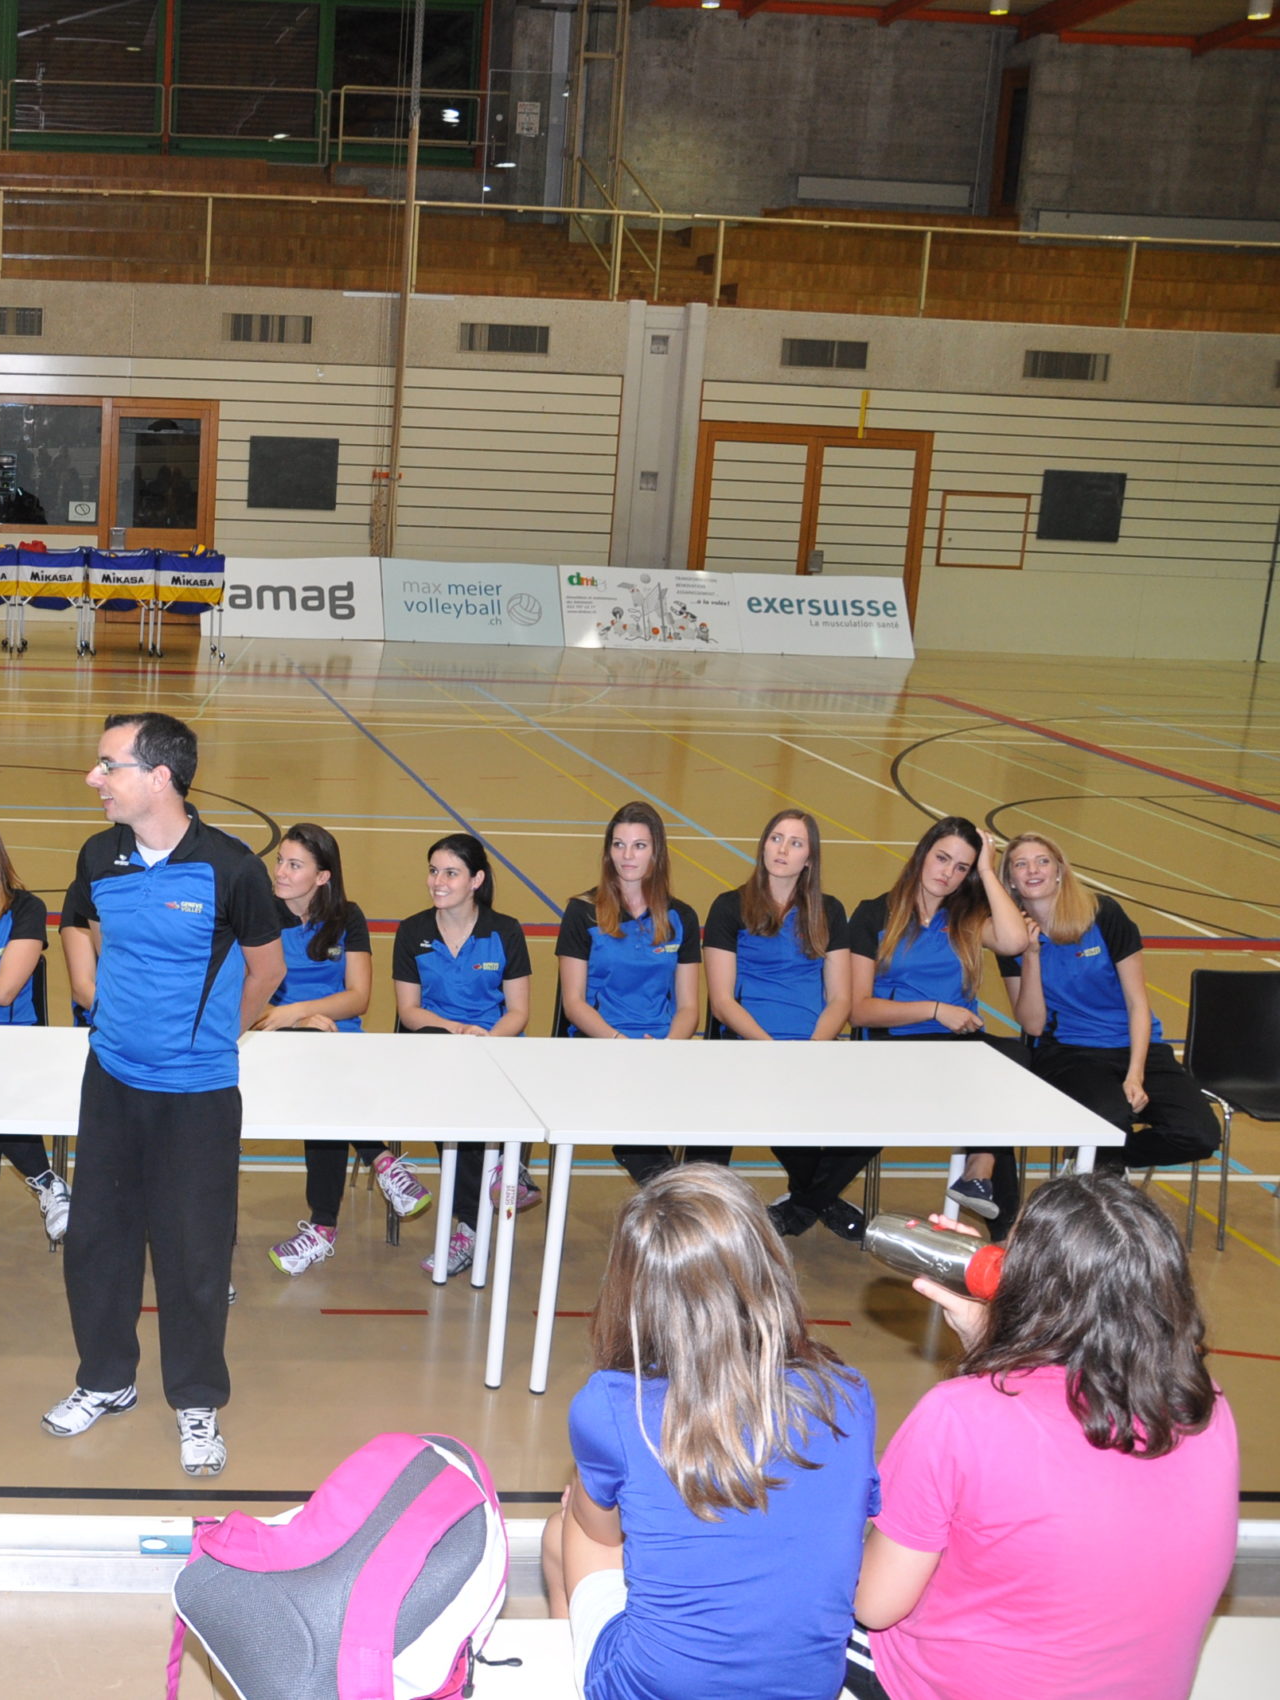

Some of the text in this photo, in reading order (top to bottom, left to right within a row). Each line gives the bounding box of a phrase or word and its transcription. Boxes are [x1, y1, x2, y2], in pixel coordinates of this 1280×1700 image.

[402, 580, 503, 597] max meier
[228, 581, 356, 620] amag
[403, 596, 502, 619] volleyball
[746, 595, 898, 618] exersuisse
[822, 619, 875, 628] musculation
[877, 620, 900, 629] santé
